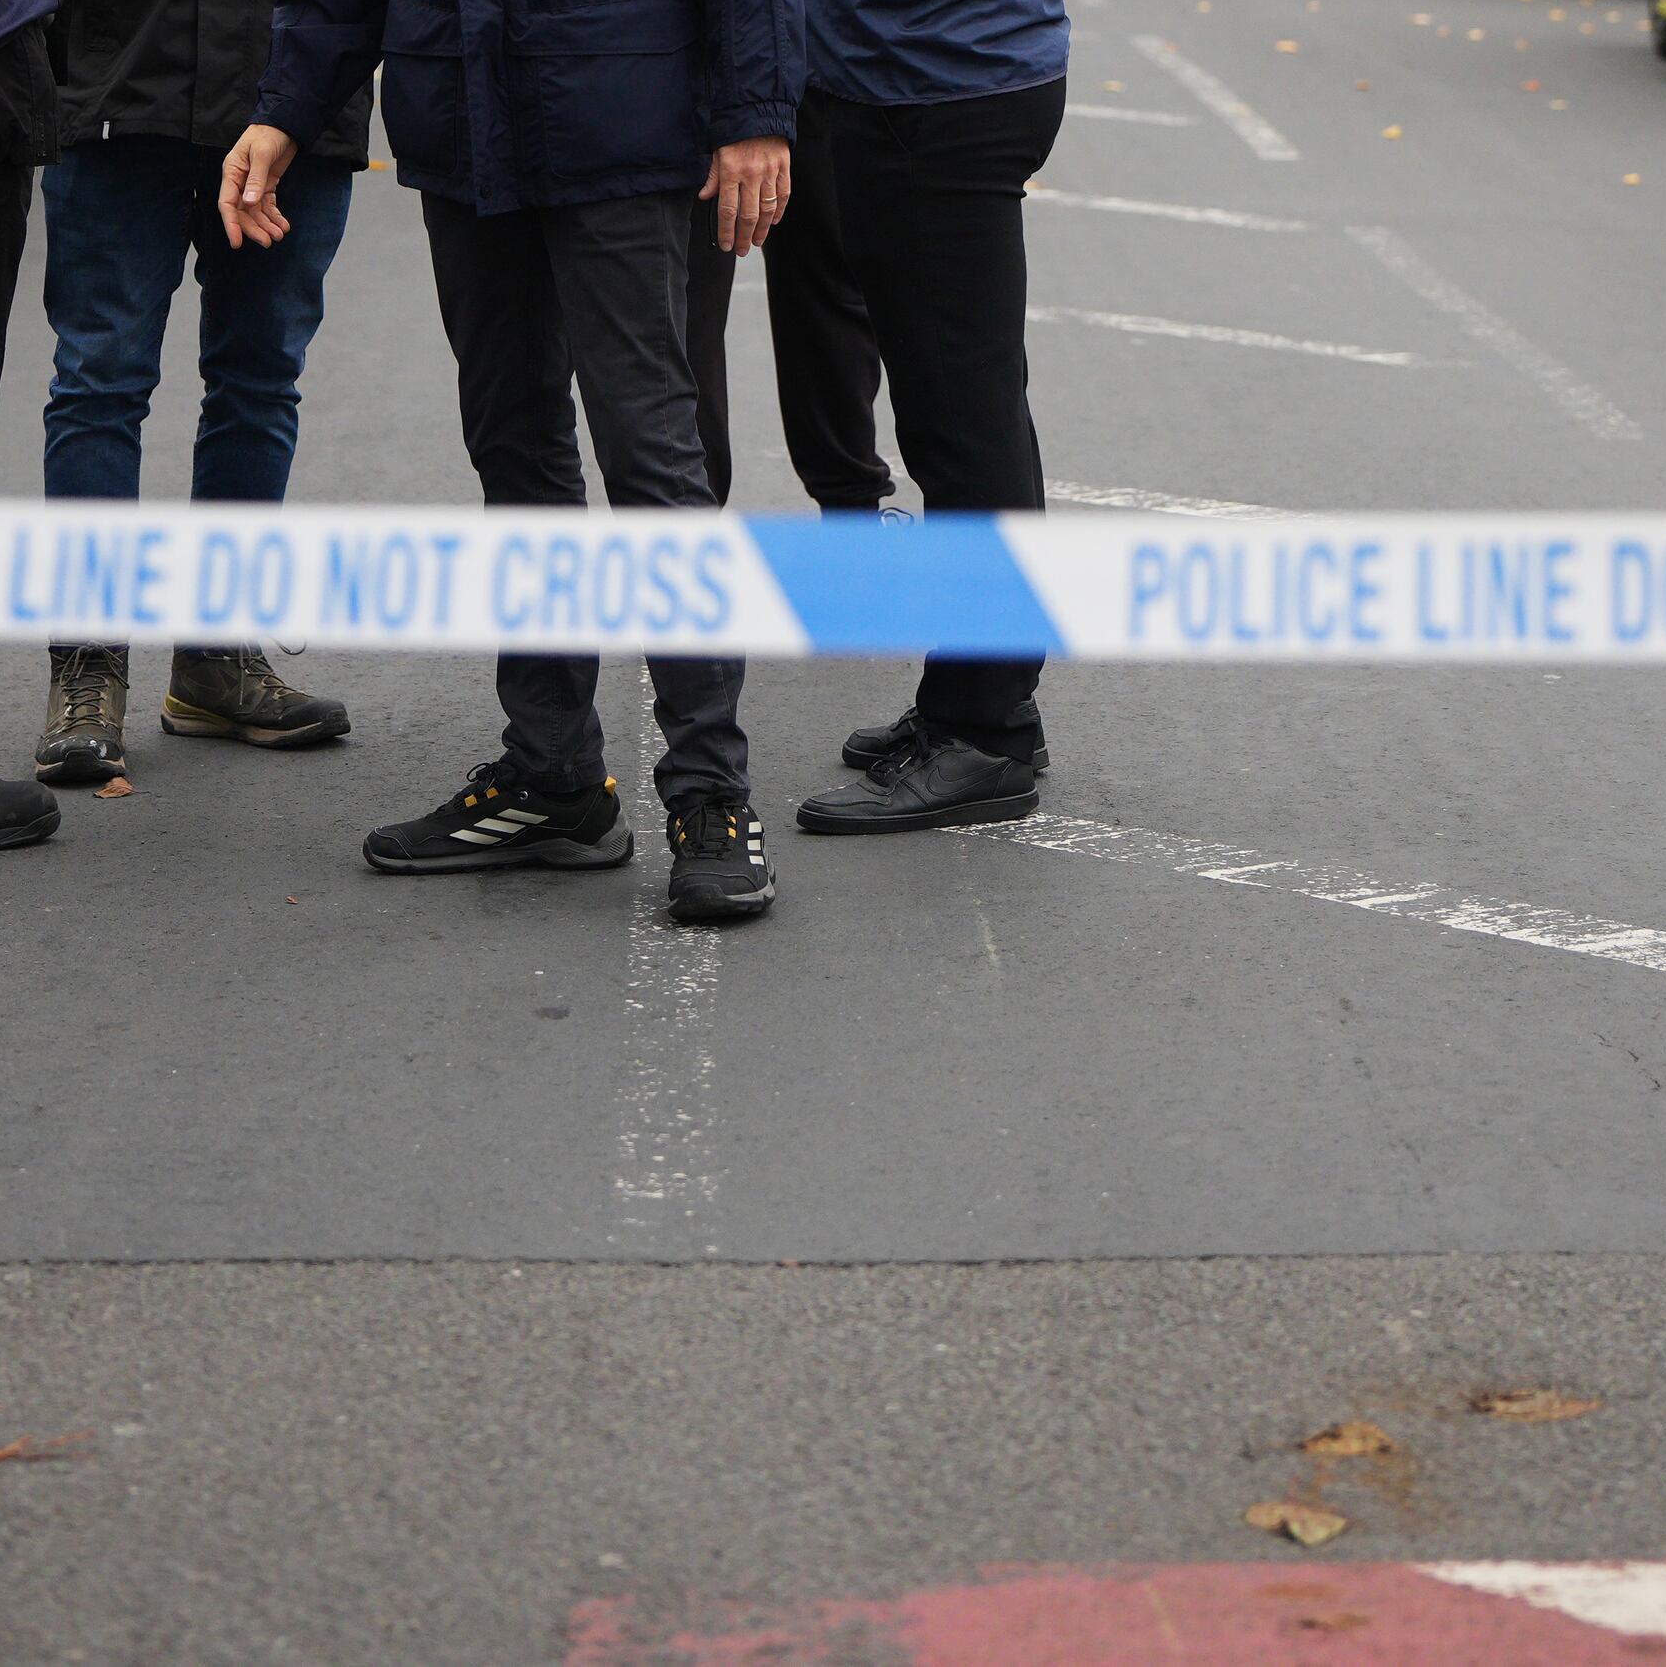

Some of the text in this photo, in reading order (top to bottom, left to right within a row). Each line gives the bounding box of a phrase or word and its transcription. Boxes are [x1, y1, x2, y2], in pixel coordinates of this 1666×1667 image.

[10, 526, 163, 625] LINE
[195, 531, 293, 629] DO
[322, 534, 462, 631] NOT
[492, 535, 733, 634] CROSS
[1130, 540, 1383, 644] POLICE
[1418, 541, 1577, 644] LINE
